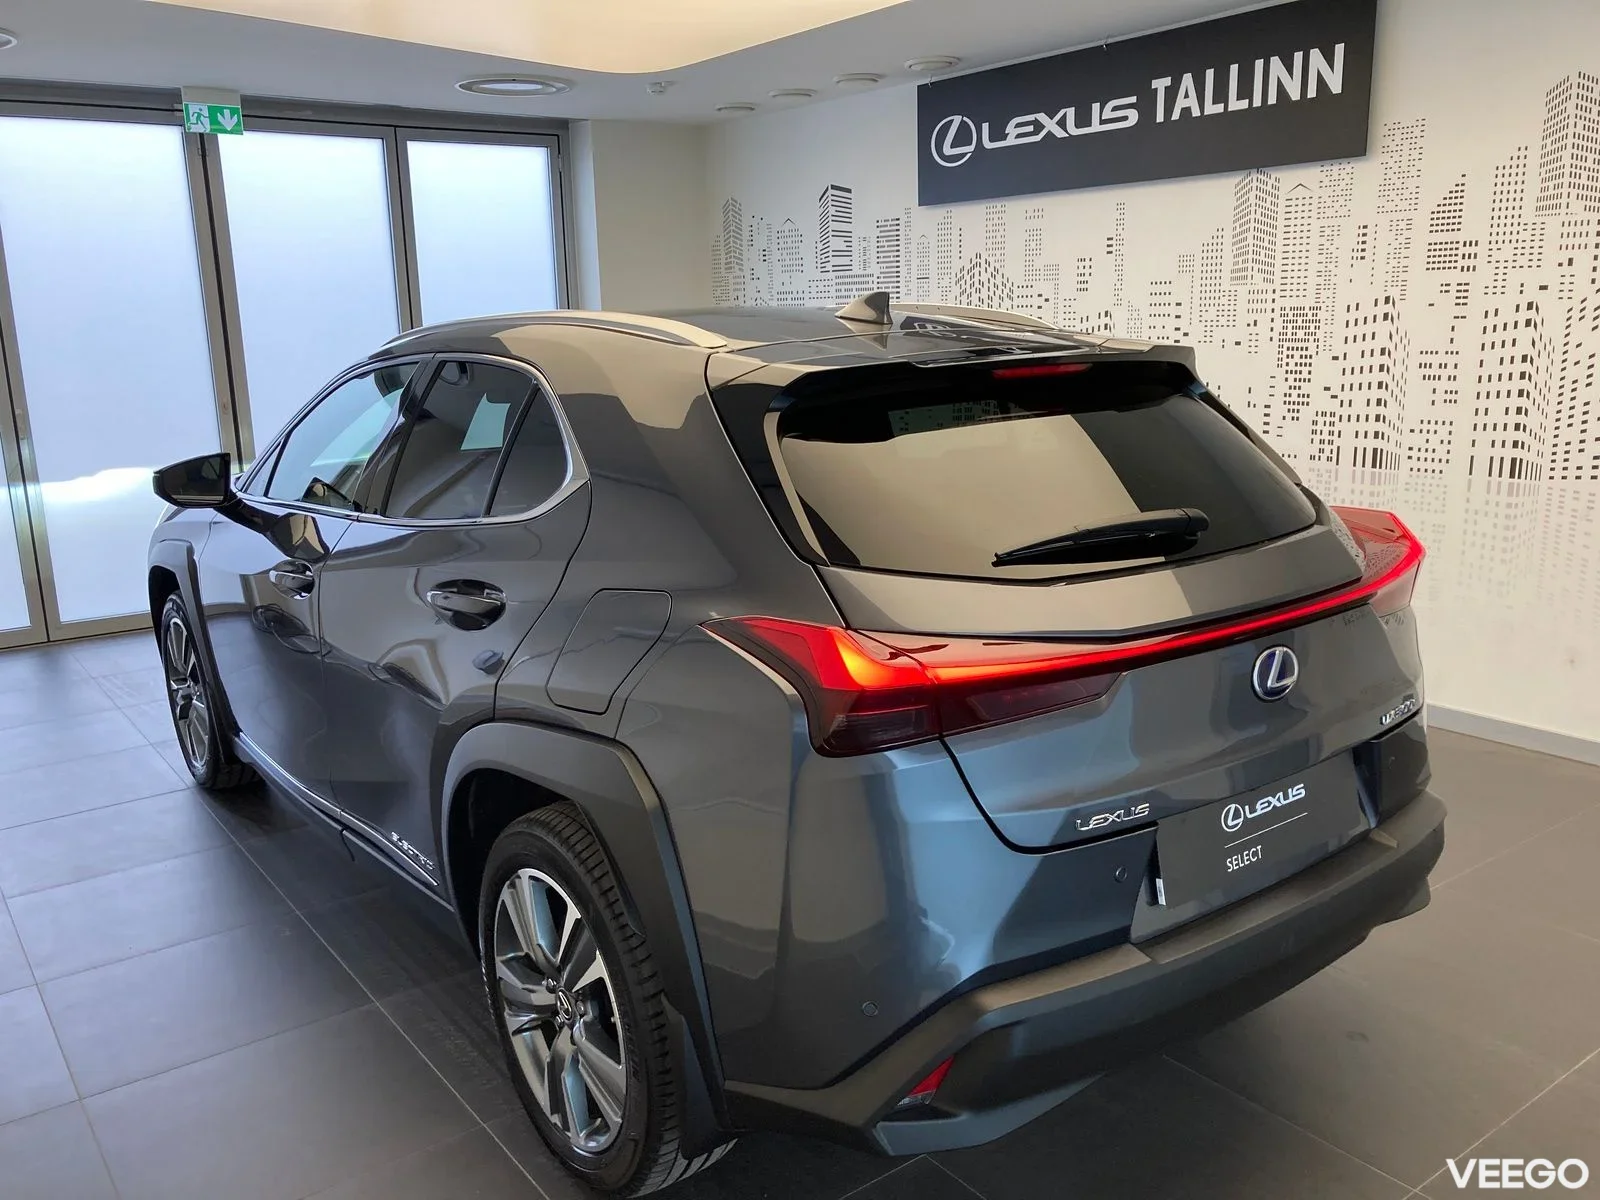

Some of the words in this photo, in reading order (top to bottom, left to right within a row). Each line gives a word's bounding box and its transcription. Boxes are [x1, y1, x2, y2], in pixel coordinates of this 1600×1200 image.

[982, 95, 1138, 149] LEXUS
[1151, 43, 1345, 123] TALLINN
[1245, 783, 1306, 818] LEXUS
[1076, 803, 1150, 831] LEXUS
[1226, 845, 1262, 872] SELECT
